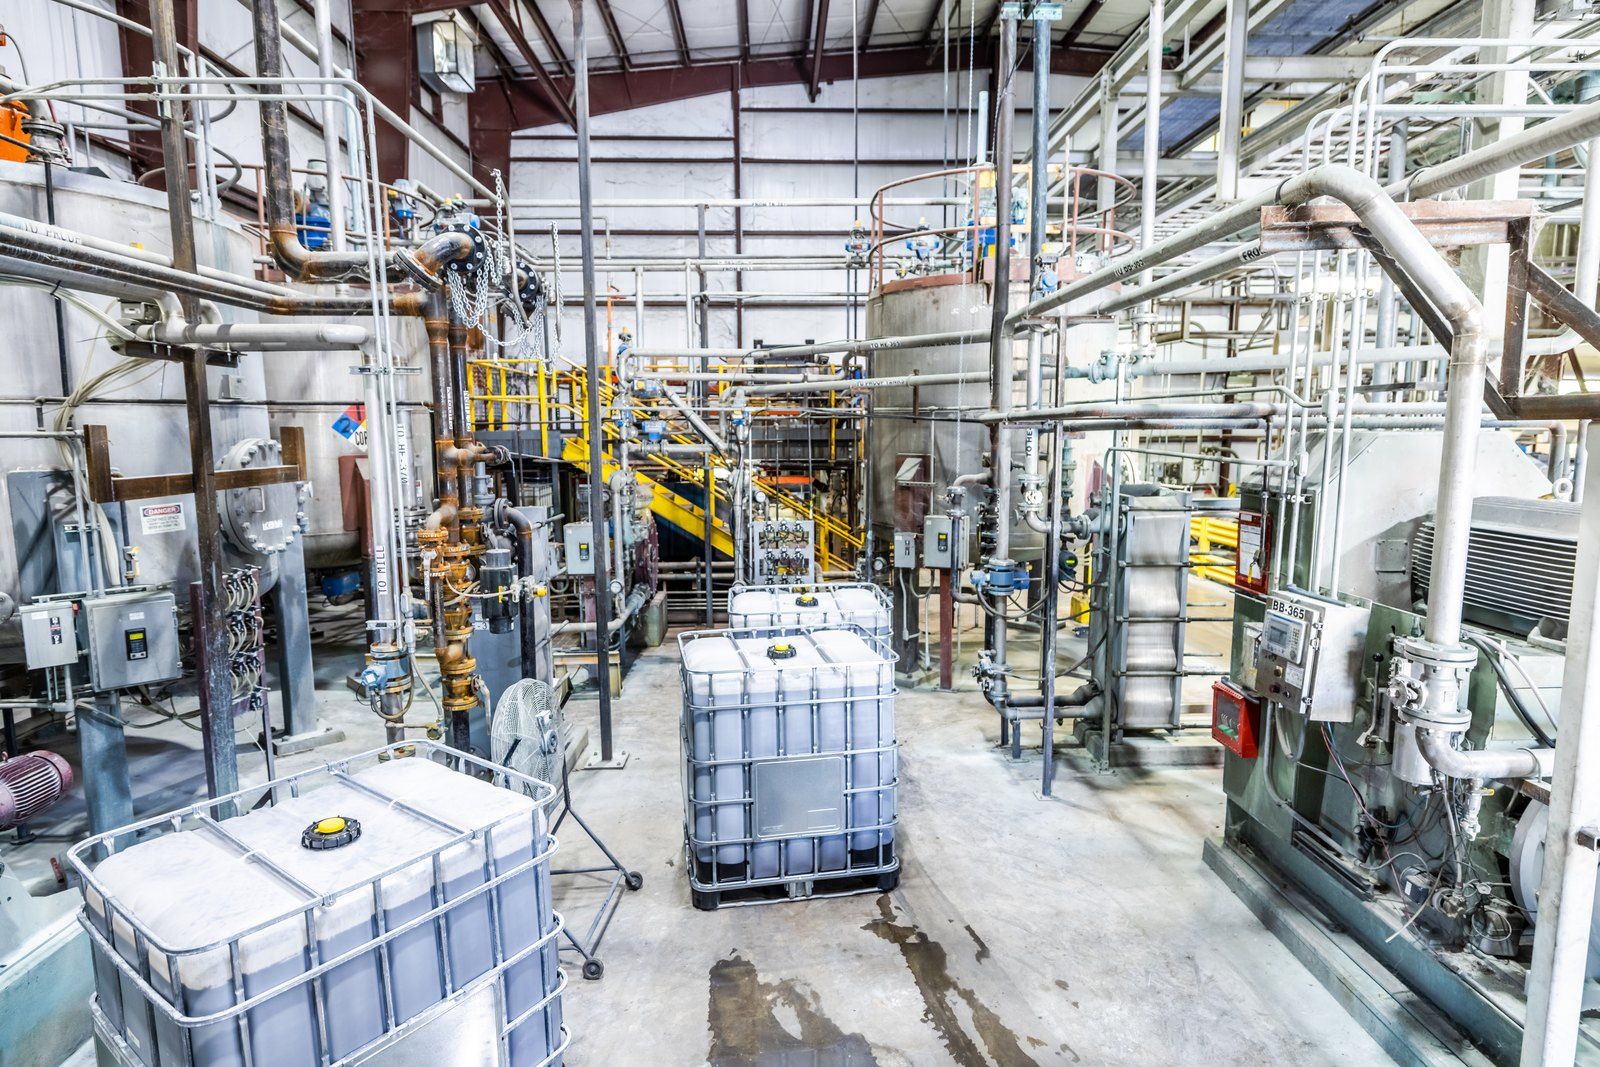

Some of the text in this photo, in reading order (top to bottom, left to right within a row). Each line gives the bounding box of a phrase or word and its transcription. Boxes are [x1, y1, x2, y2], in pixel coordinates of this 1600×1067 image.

[1242, 246, 1262, 261] FRO
[339, 417, 351, 432] 2
[148, 507, 177, 515] DANGER
[376, 546, 387, 593] TO MILL
[1273, 600, 1305, 620] BB-365
